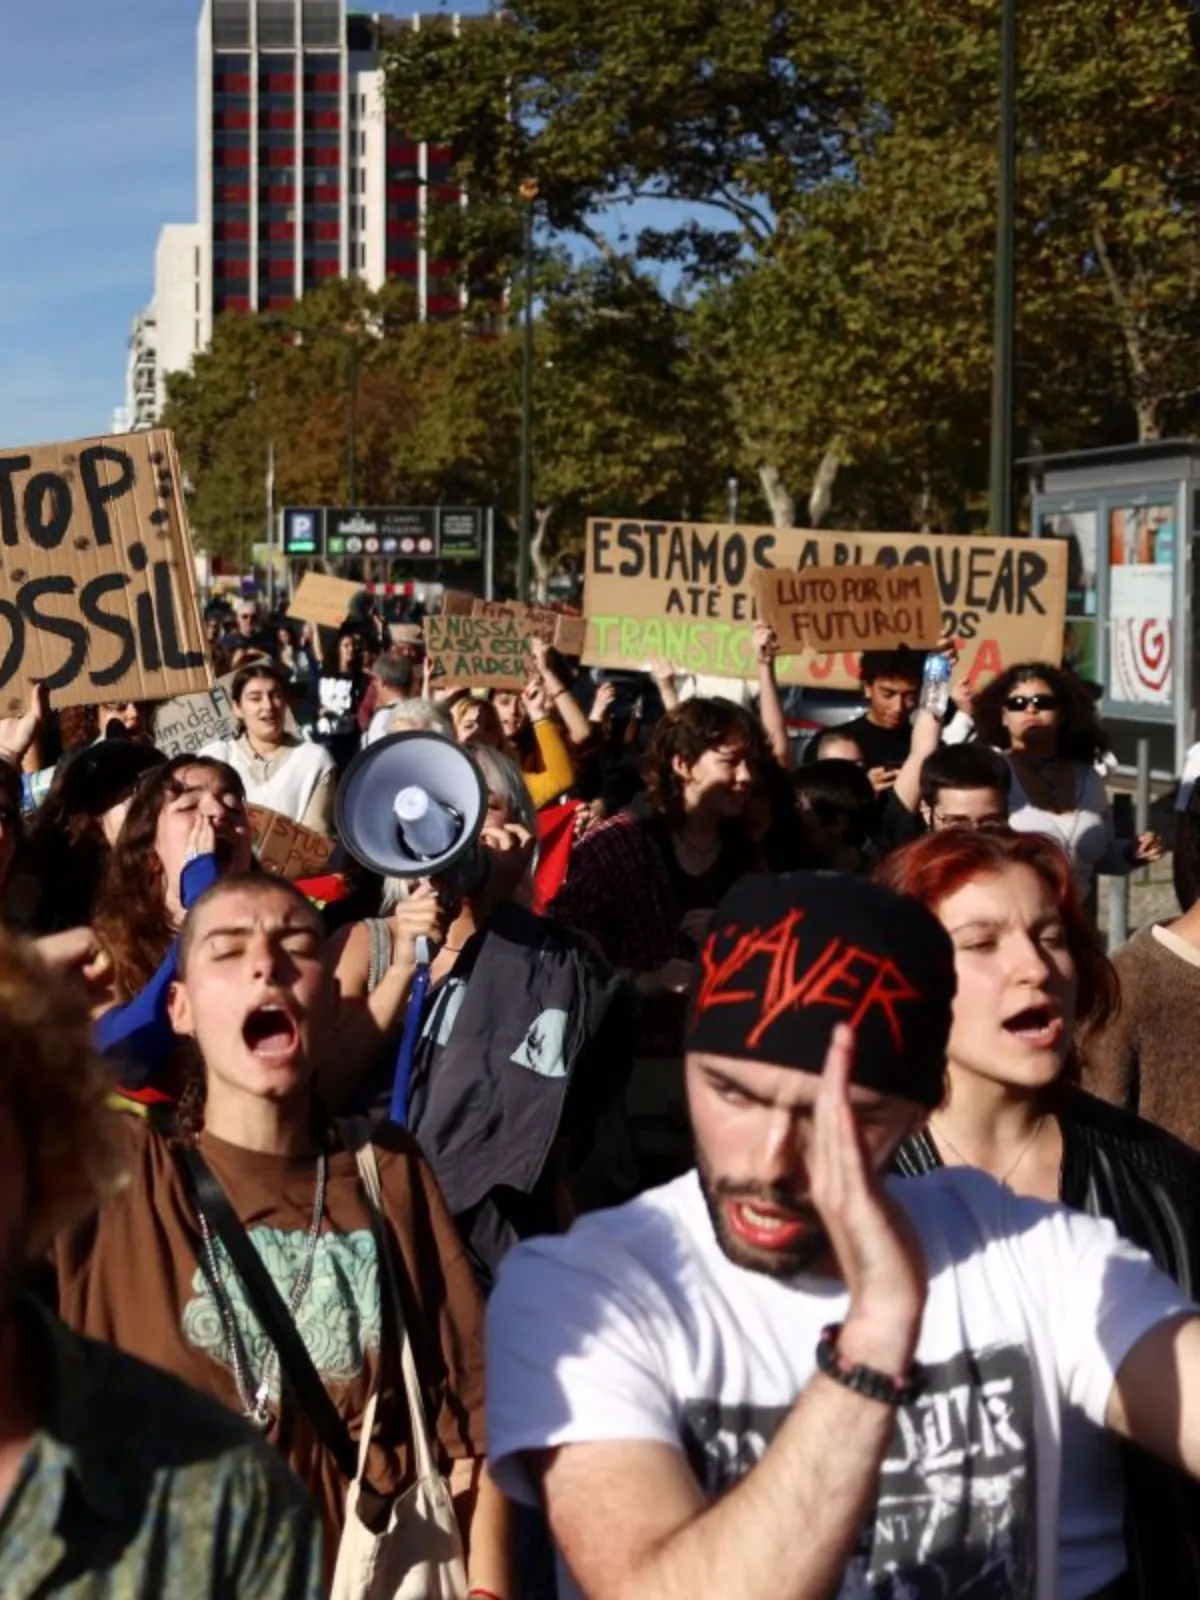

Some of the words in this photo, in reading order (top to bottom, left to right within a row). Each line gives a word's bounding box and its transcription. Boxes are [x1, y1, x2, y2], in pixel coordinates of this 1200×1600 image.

[665, 584, 722, 619] ATÉ
[776, 578, 837, 605] LUTO
[841, 578, 883, 603] POR
[886, 575, 922, 601] UM
[446, 617, 518, 638] NOSSA
[791, 607, 926, 642] FUTURO!
[429, 637, 484, 652] CASA
